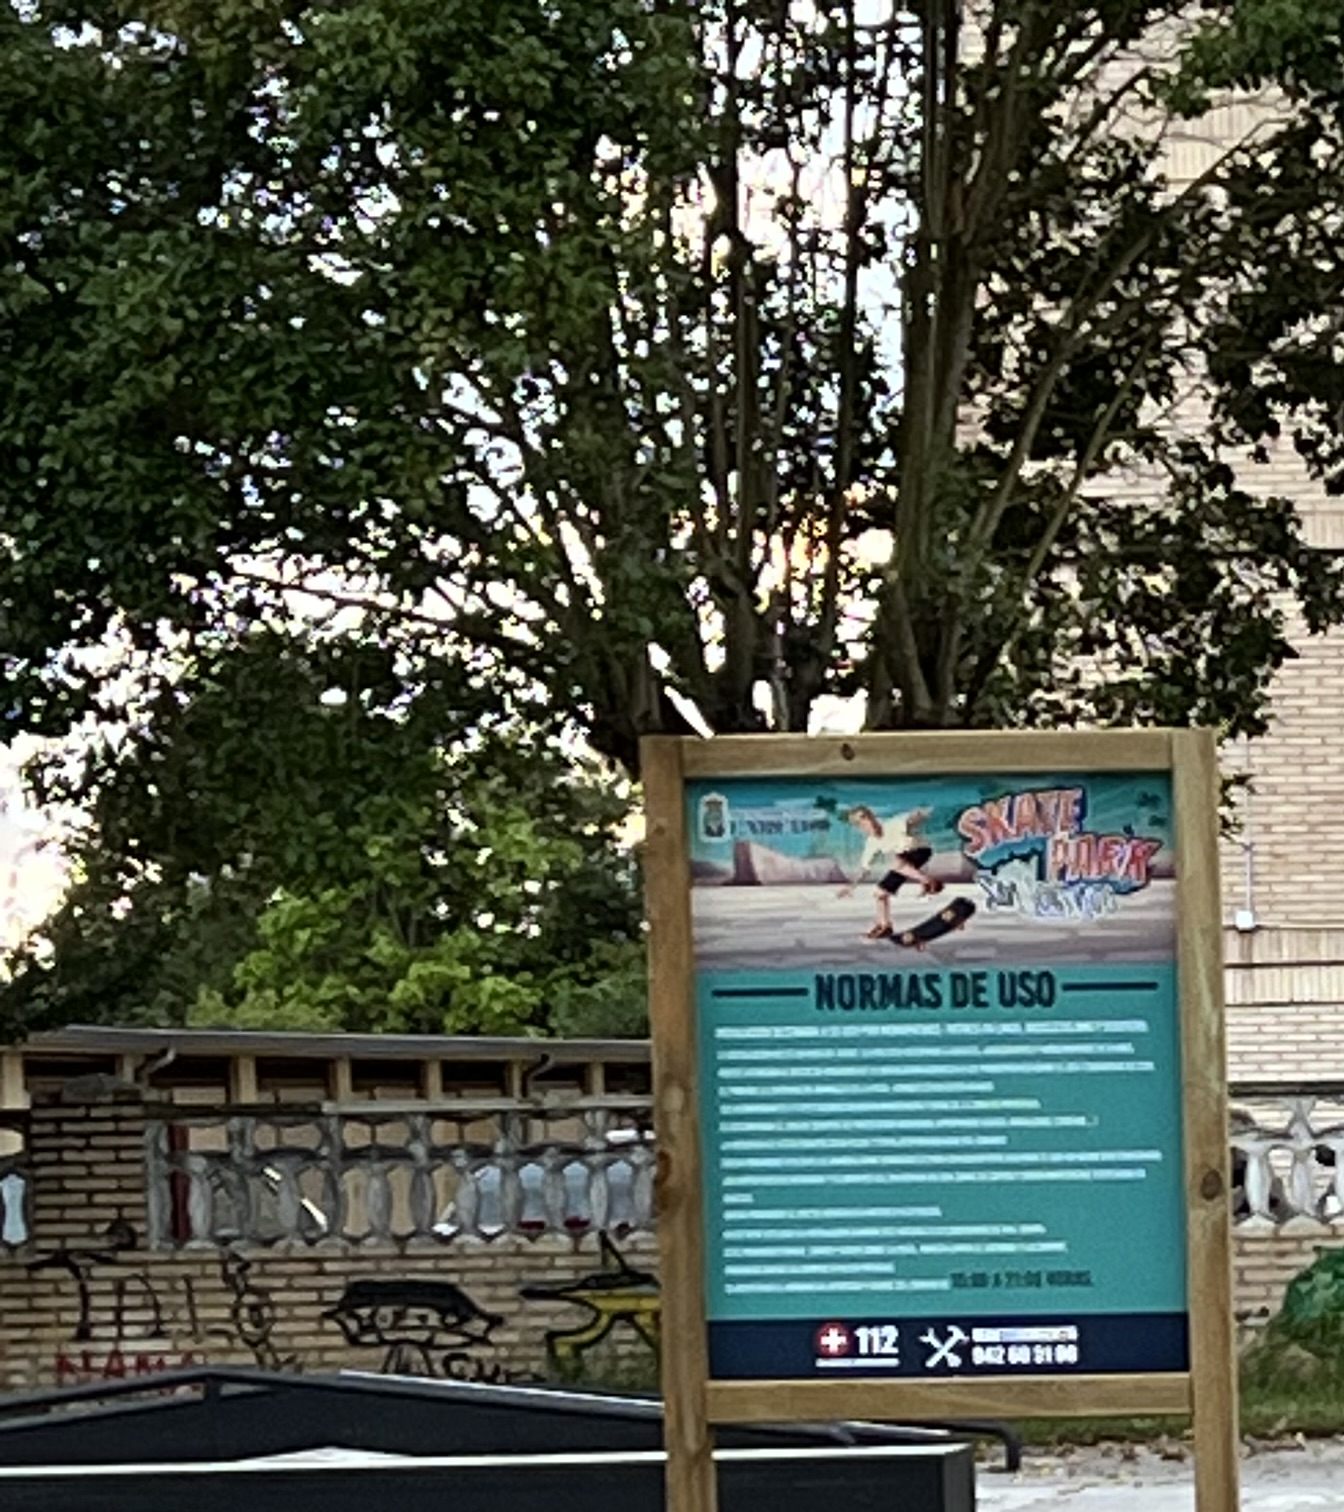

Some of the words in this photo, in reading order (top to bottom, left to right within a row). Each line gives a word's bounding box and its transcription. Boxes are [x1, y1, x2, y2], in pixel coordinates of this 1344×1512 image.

[958, 786, 1084, 858] SKATE
[1046, 834, 1162, 884] PARK
[814, 973, 943, 1011] NORMAS
[950, 971, 989, 1008] DE
[998, 970, 1056, 1008] USO
[854, 1324, 899, 1355] 112
